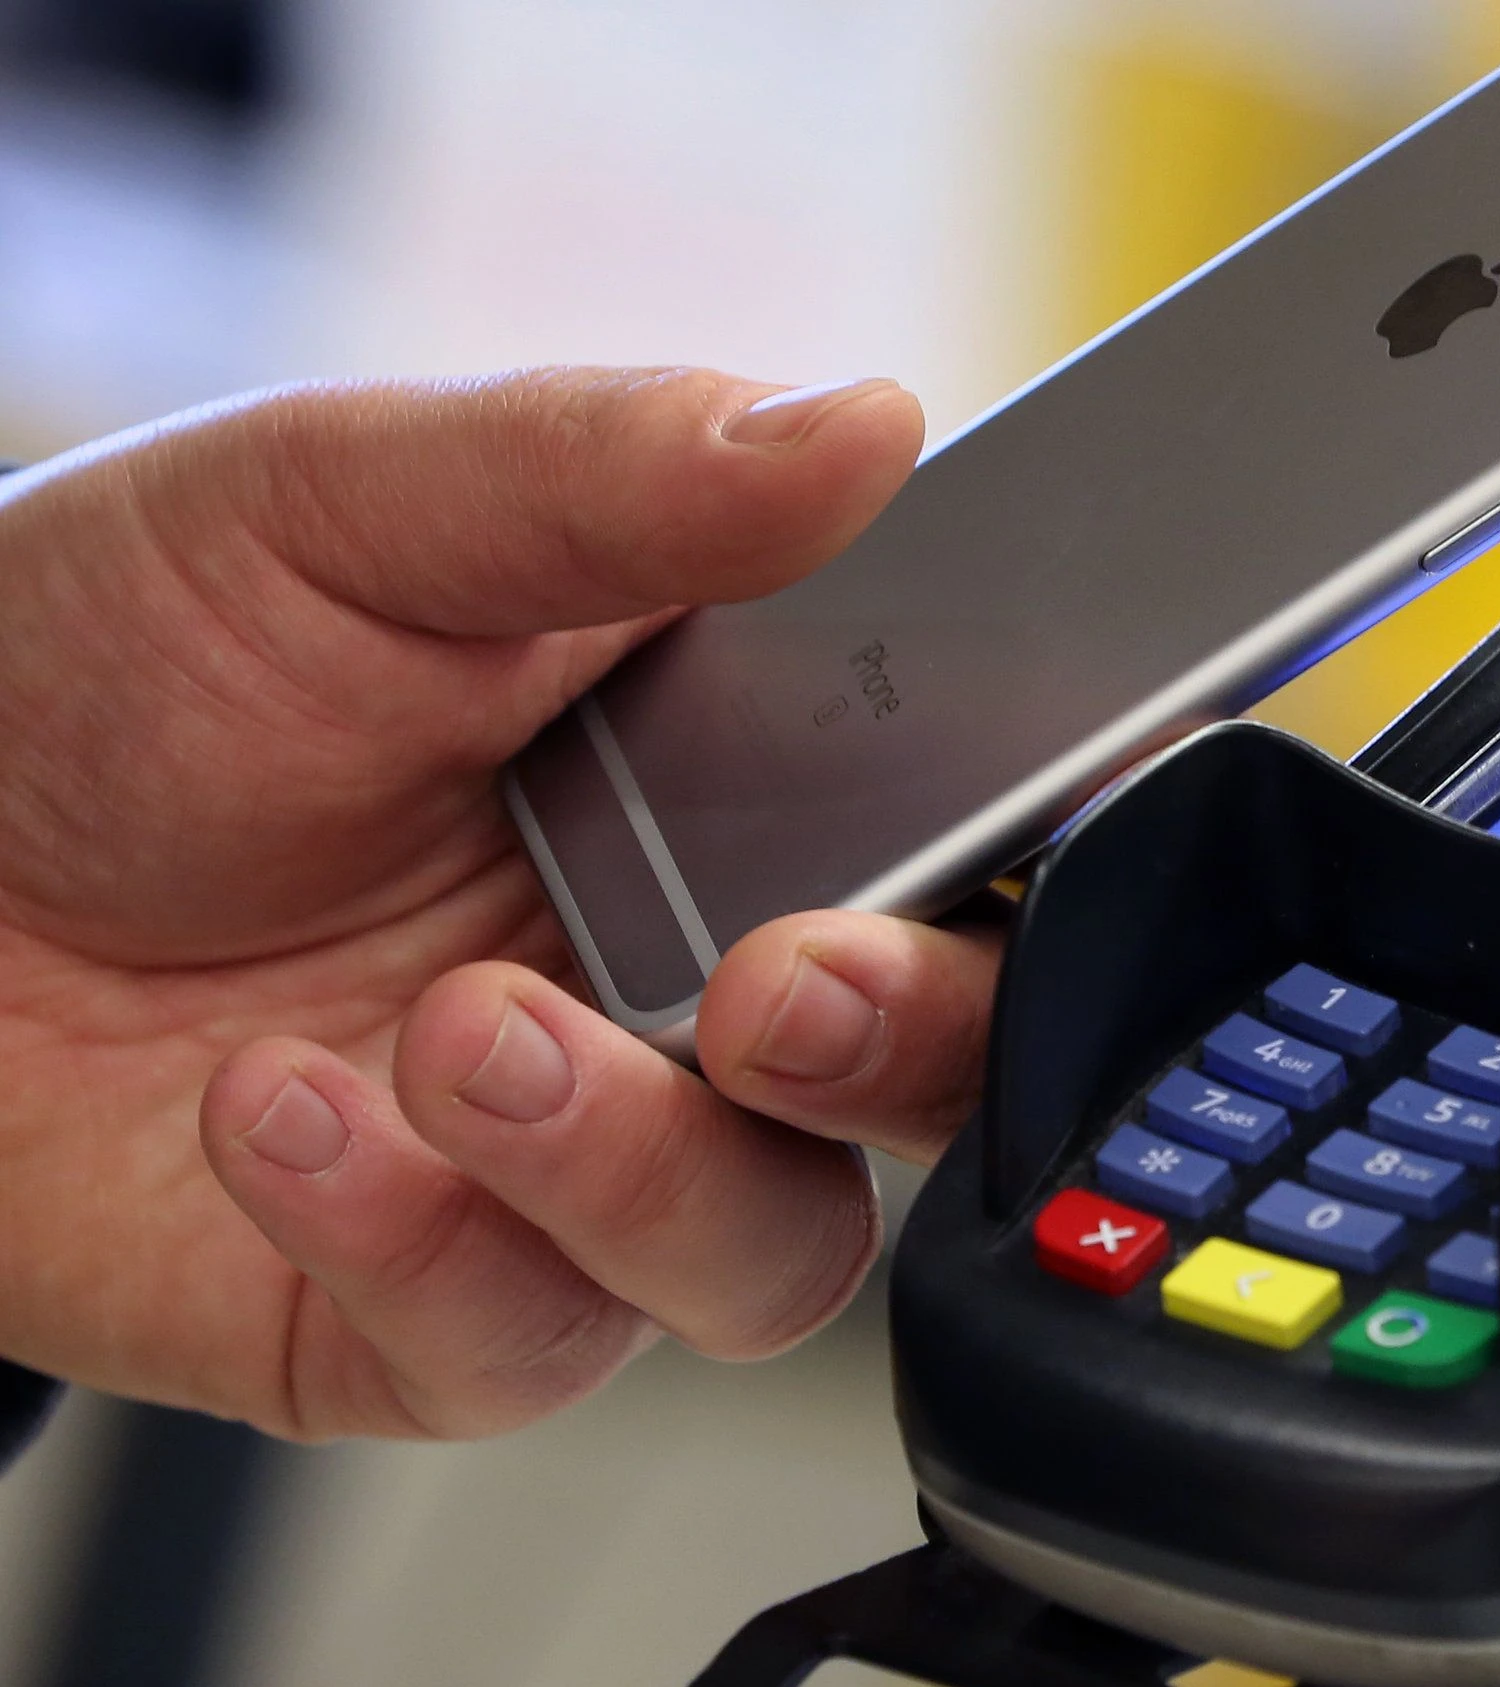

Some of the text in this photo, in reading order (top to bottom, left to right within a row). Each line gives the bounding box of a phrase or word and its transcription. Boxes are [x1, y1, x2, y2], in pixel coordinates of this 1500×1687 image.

[1320, 987, 1347, 1010] 1
[1253, 1039, 1285, 1063] 4
[1190, 1088, 1230, 1113] 7
[1423, 1097, 1463, 1124] 5
[1363, 1148, 1402, 1176] 8
[1306, 1203, 1344, 1230] 0
